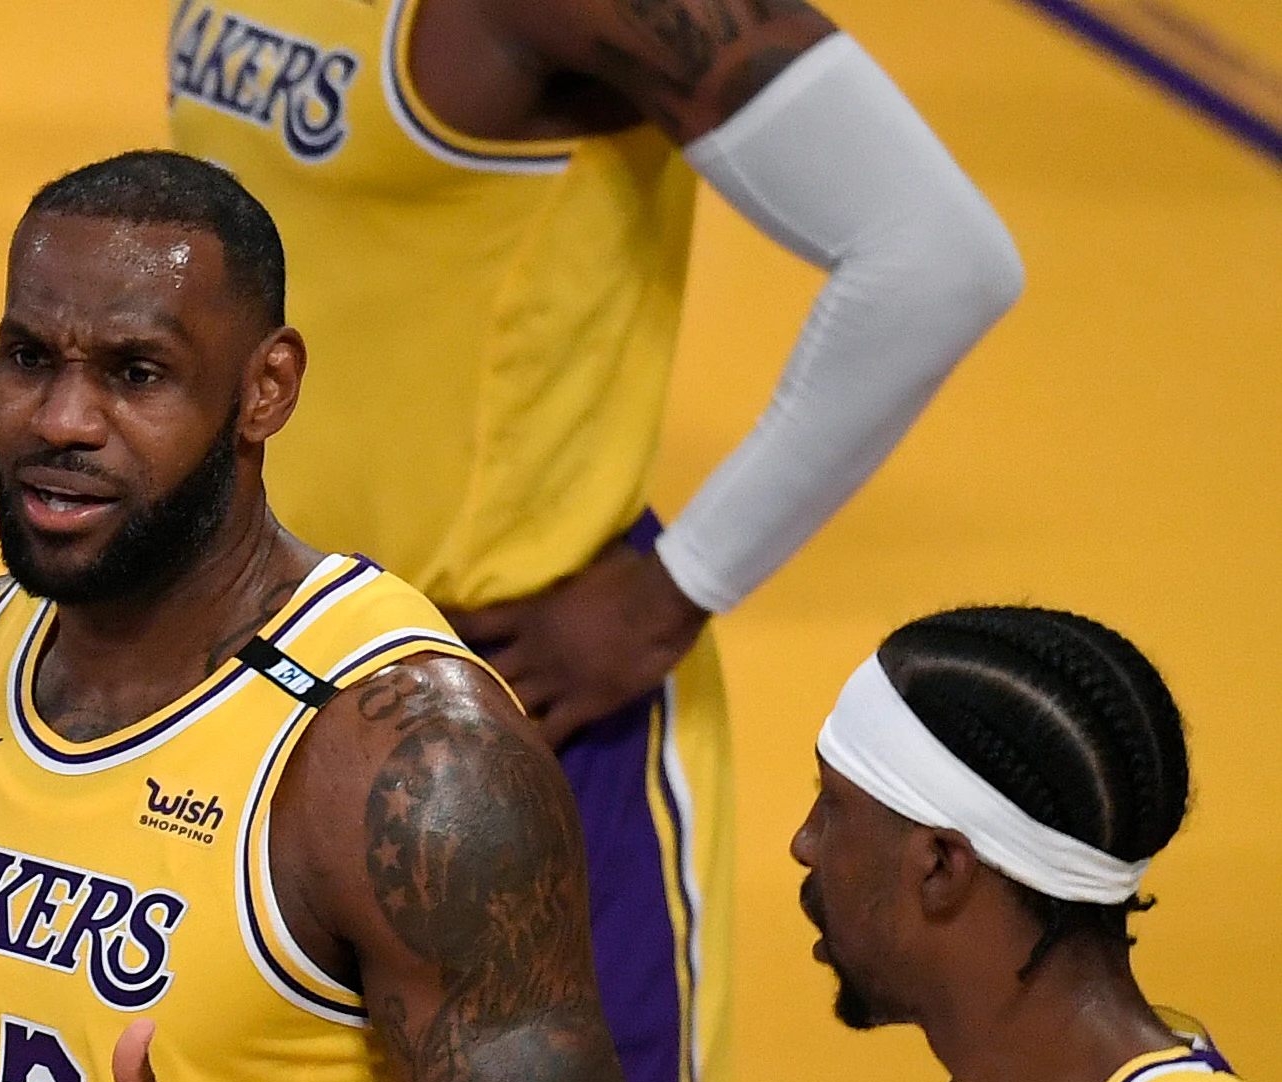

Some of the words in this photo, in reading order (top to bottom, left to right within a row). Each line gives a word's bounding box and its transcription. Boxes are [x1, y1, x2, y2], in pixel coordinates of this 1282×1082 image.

[168, 0, 360, 163] AKERS
[138, 814, 214, 844] SHOPPING
[146, 777, 224, 830] wish
